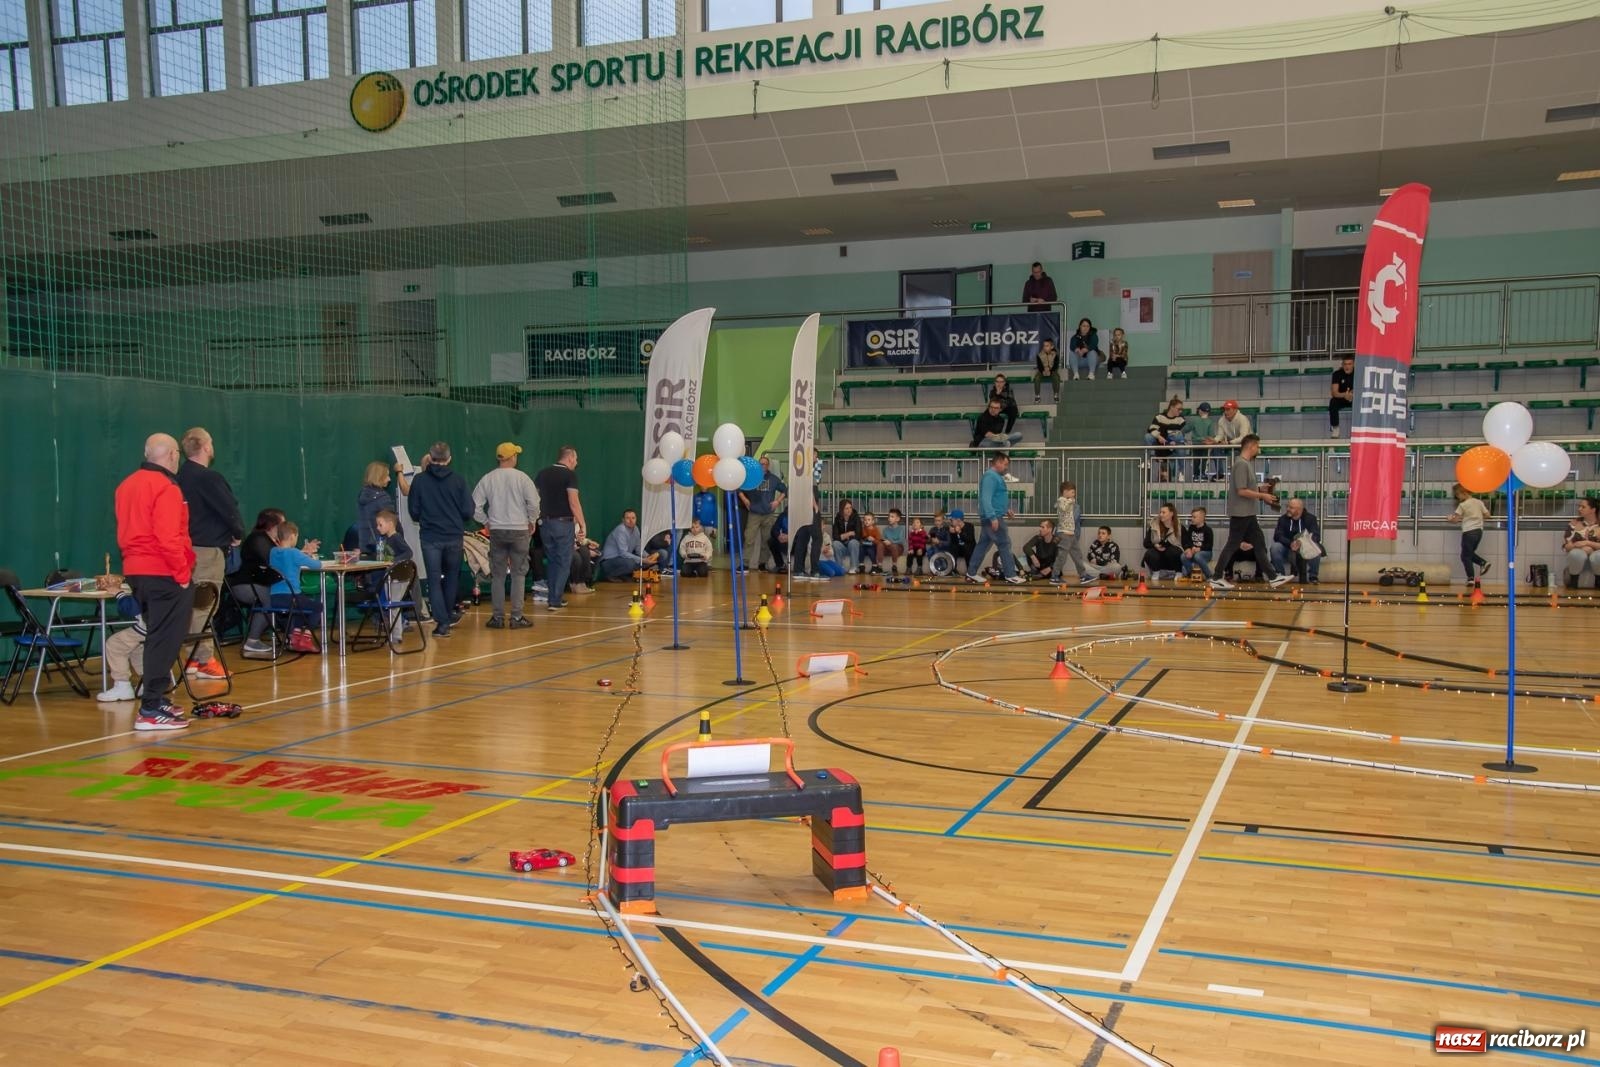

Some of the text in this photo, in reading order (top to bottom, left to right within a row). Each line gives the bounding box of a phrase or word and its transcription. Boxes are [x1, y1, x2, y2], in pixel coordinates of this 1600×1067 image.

[413, 3, 1045, 107] OŚRODEK SPORTU I REKREACJI RACIBÓRZ
[1090, 246, 1100, 257] F
[544, 344, 617, 362] RACIBÓRZ
[949, 327, 1039, 347] RACIBÓRZ
[652, 378, 685, 459] SiR
[684, 379, 698, 441] RACIBÓRZ
